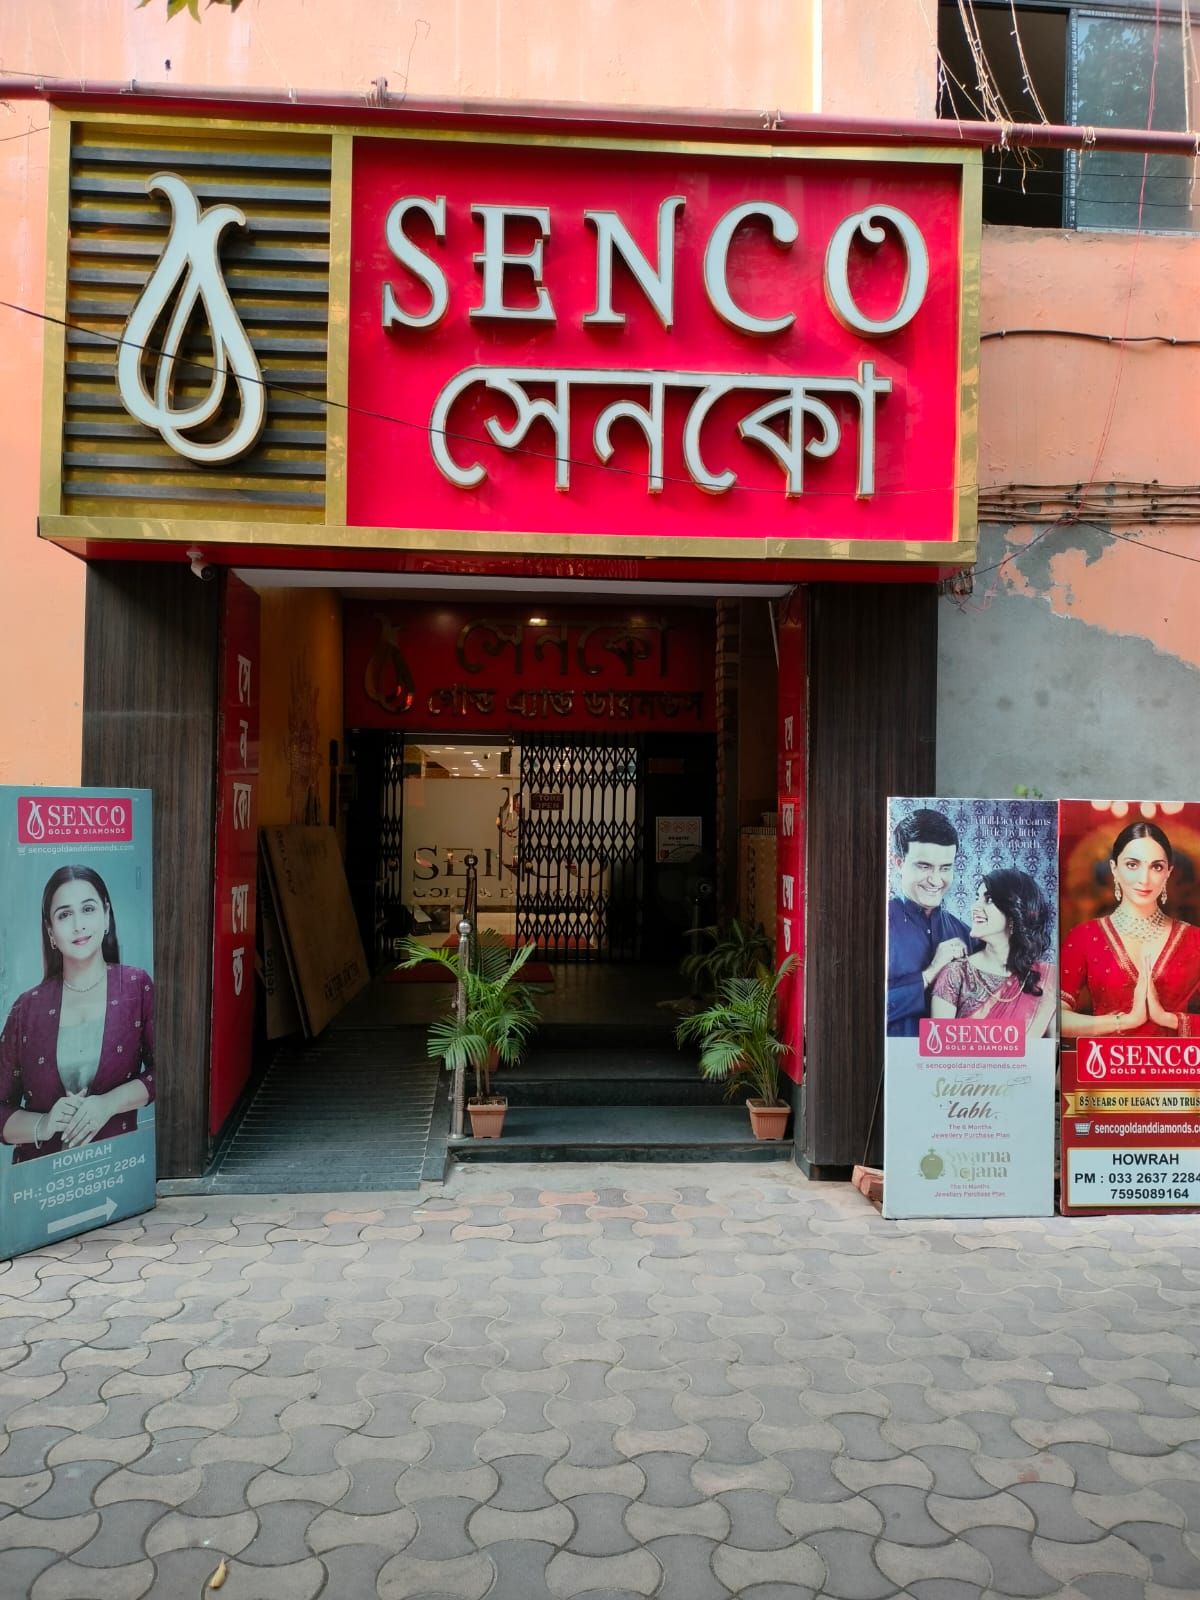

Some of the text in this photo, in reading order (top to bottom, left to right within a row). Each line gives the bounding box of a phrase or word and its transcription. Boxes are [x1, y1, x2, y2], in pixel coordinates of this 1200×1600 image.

[381, 195, 930, 338] SENCO
[428, 361, 893, 500] সেনকো
[456, 616, 671, 677] সেনকো
[47, 804, 126, 827] SENCO
[47, 828, 72, 836] GOLD
[945, 1024, 1019, 1044] SENCO
[1109, 1044, 1200, 1067] SENCO
[931, 1077, 1009, 1099] Swarna
[1079, 1096, 1090, 1106] 85
[1091, 1096, 1117, 1106] YEARS
[1119, 1096, 1129, 1106] OF
[1131, 1096, 1160, 1106] LEGACY
[1162, 1096, 1179, 1106] AND
[52, 1143, 112, 1170] HOWRAH
[1112, 1153, 1180, 1165] HOWRAH
[46, 1175, 75, 1194] 033
[77, 1163, 111, 1185] 2637
[114, 1153, 146, 1173] 2284
[1074, 1172, 1096, 1184] PM
[1108, 1172, 1133, 1184] 033
[1136, 1172, 1167, 1184] 2637
[39, 1174, 125, 1211] 7595089164
[1110, 1188, 1190, 1199] 7595089164
